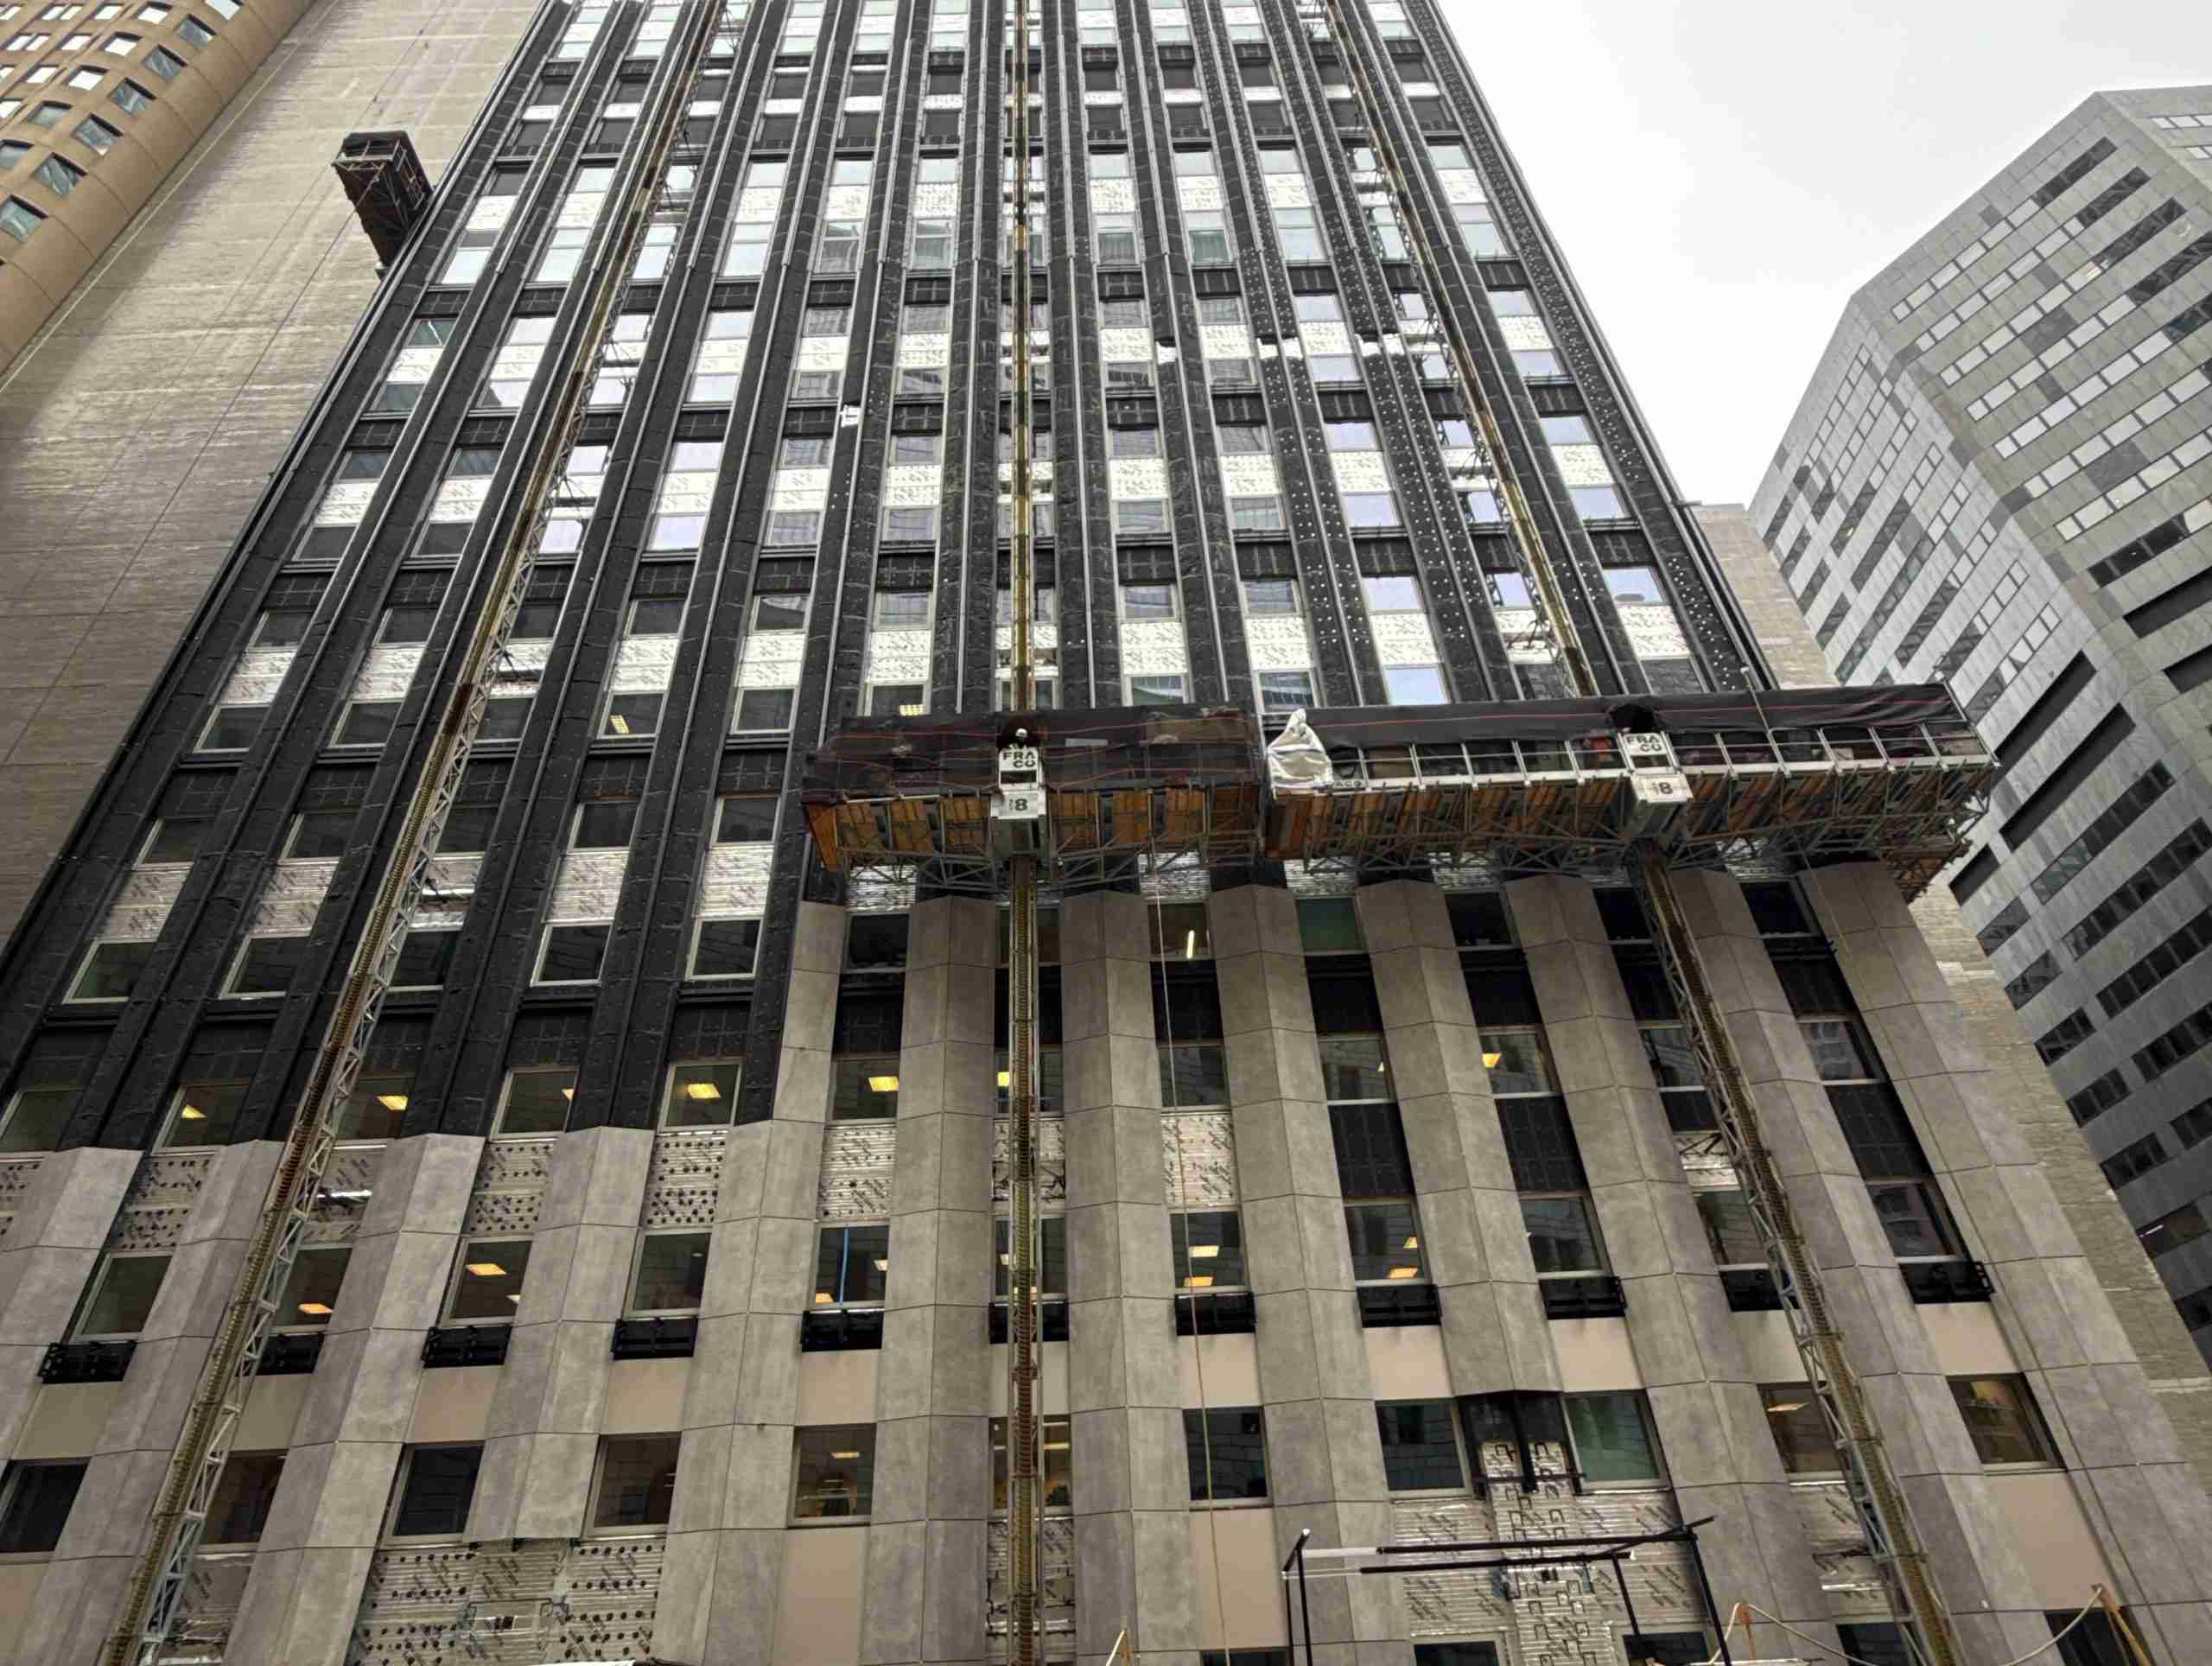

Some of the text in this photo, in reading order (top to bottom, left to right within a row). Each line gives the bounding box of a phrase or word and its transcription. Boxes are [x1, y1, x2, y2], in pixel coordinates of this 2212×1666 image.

[1626, 735, 1660, 744] FRA
[1640, 744, 1662, 753] CO
[1003, 751, 1035, 760] FRA
